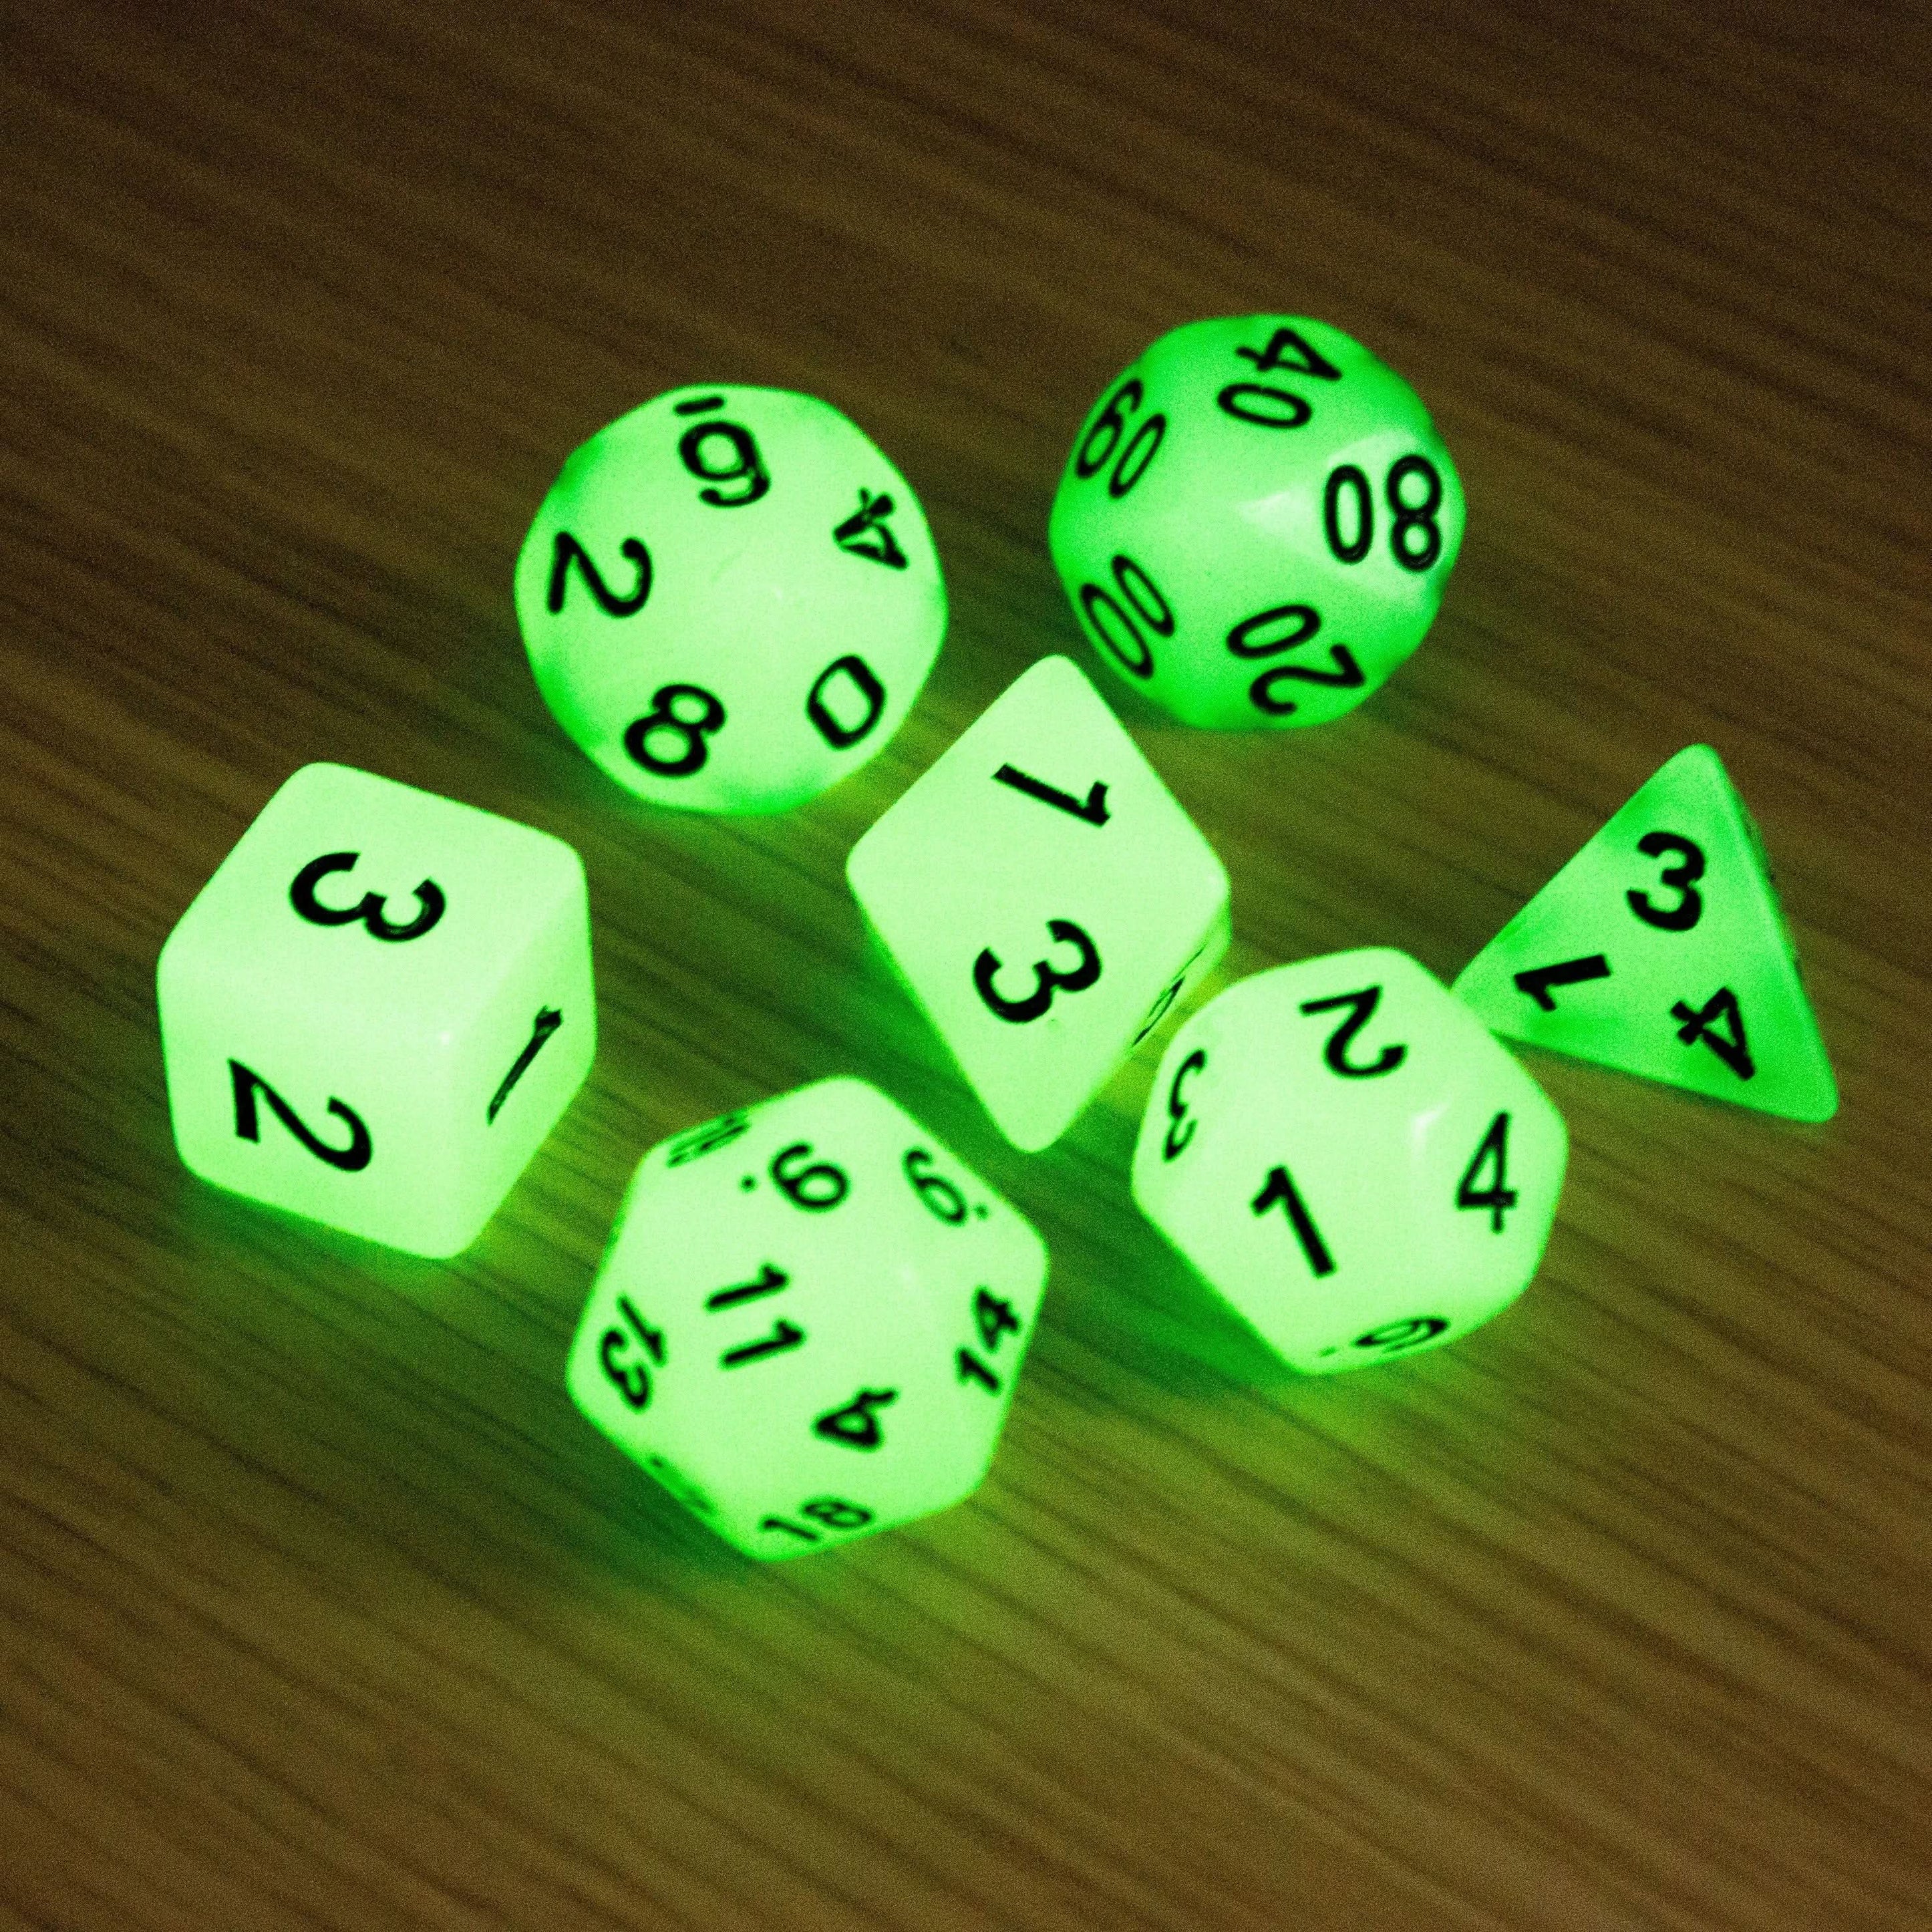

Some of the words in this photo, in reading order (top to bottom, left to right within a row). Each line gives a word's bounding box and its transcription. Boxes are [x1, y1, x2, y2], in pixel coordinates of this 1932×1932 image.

[1216, 326, 1343, 430] 40
[1074, 377, 1167, 499] 60
[834, 489, 907, 569] 4
[1323, 453, 1443, 573] 80
[547, 530, 653, 618] 2
[1078, 553, 1176, 681] 00
[806, 655, 885, 749] 0
[1225, 603, 1367, 717] 20
[623, 683, 726, 778] 8
[993, 764, 1110, 826] 1
[289, 852, 446, 943] 3
[1626, 830, 1706, 933] 3
[973, 919, 1102, 1023] 3
[1512, 953, 1611, 1013] 1
[487, 1004, 564, 1125] 1
[1301, 986, 1405, 1078] 2
[1669, 986, 1756, 1082] 4
[228, 1060, 372, 1172] 2
[1164, 1050, 1205, 1160] 3
[1252, 1166, 1334, 1276] 1
[1457, 1112, 1516, 1231] 4
[599, 1297, 665, 1412] 13
[706, 1265, 805, 1367] 11
[957, 1289, 1020, 1392] 14
[815, 1390, 895, 1449] 4
[762, 1499, 875, 1542] 18
